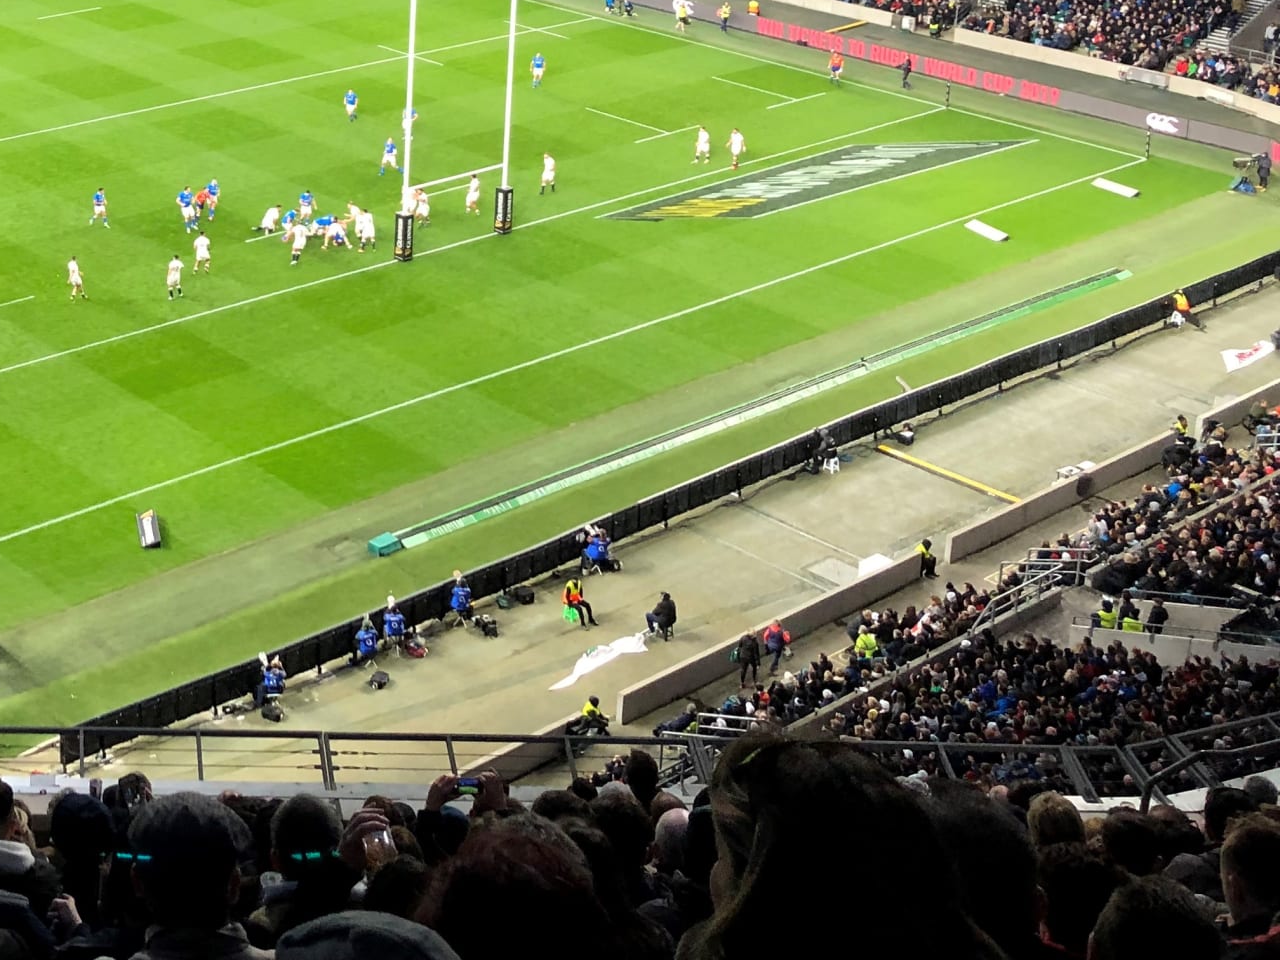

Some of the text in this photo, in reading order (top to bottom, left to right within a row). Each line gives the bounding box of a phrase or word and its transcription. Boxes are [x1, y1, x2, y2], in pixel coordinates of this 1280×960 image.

[757, 17, 783, 38] WIN
[788, 24, 843, 53] TICKETS
[848, 38, 865, 58] TO
[924, 57, 977, 86] WORLD
[983, 71, 1014, 93] CUP
[1021, 80, 1061, 106] 2019
